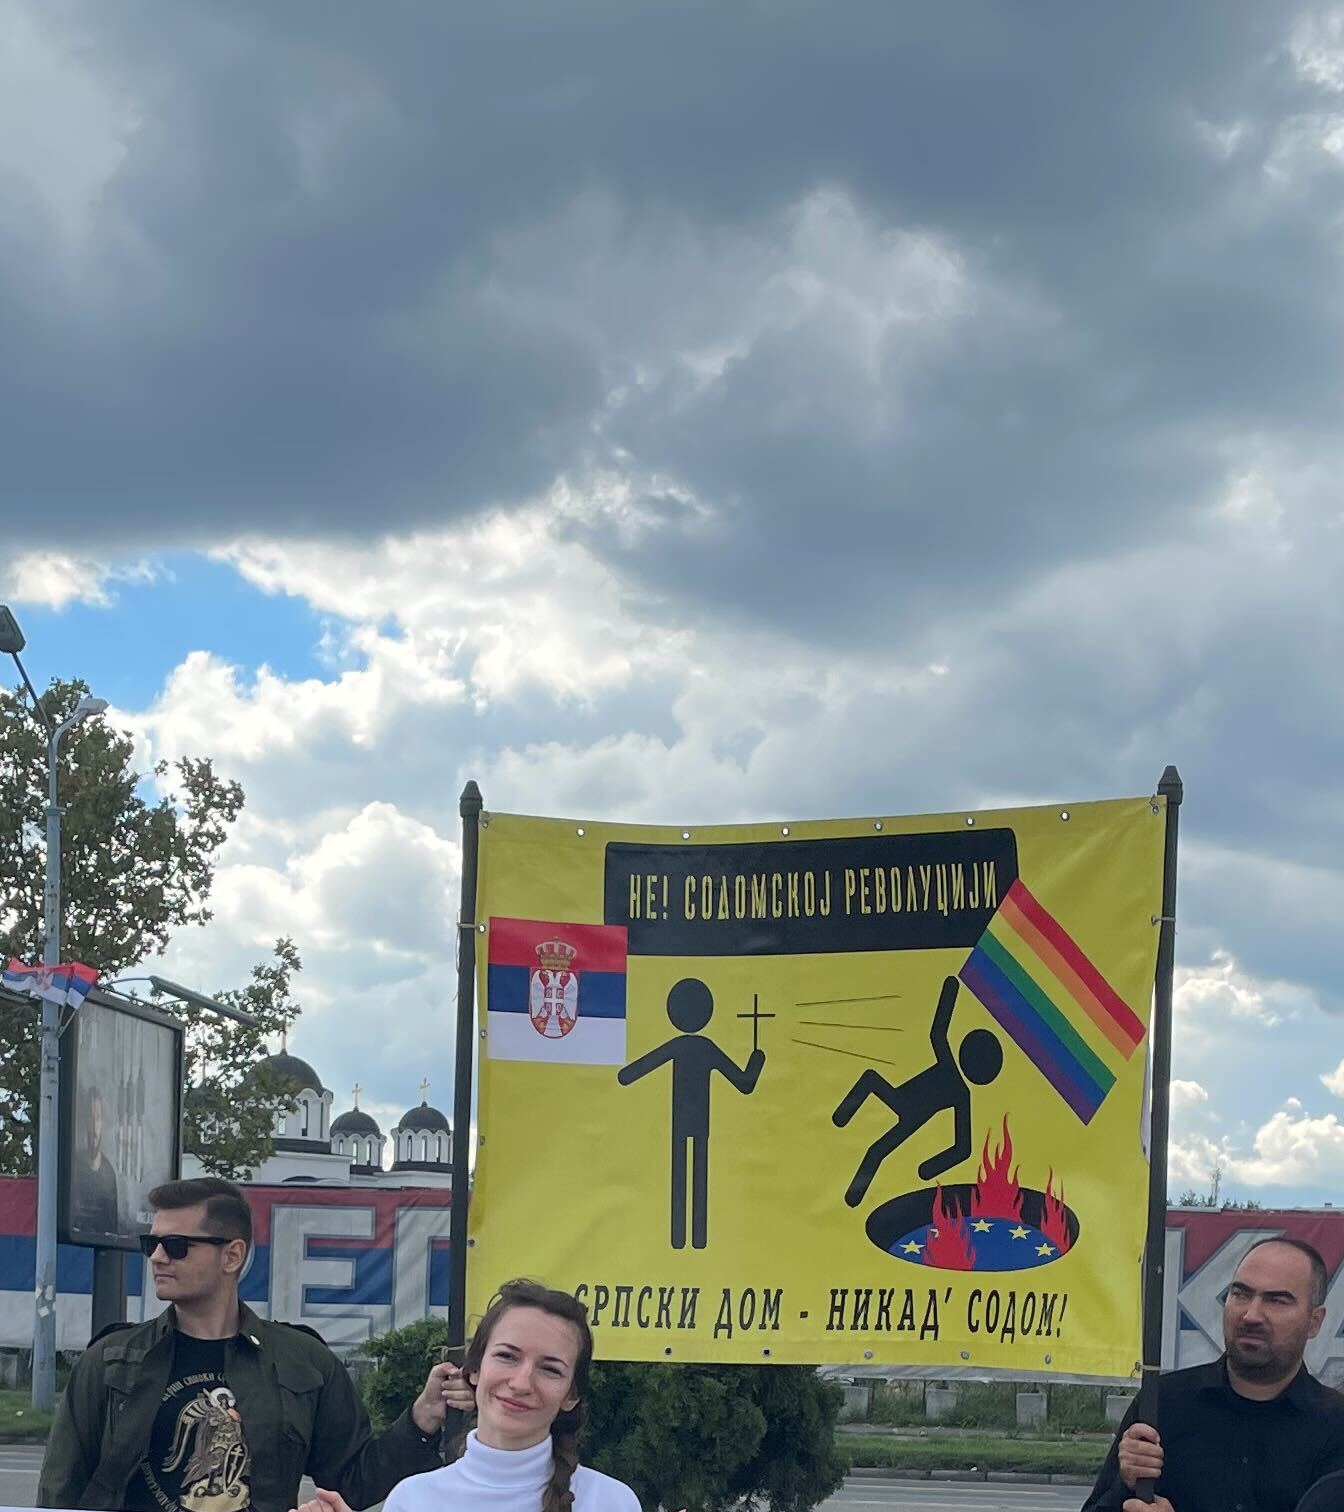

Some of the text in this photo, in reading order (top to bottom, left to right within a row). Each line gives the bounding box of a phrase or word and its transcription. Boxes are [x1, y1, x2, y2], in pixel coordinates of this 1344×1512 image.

[628, 860, 999, 921] НЕ! СОДОМСКОЈ РЕВОЛУЦИЈИ
[712, 1286, 785, 1340] ДОМ
[966, 1288, 1069, 1344] СОДОМ!
